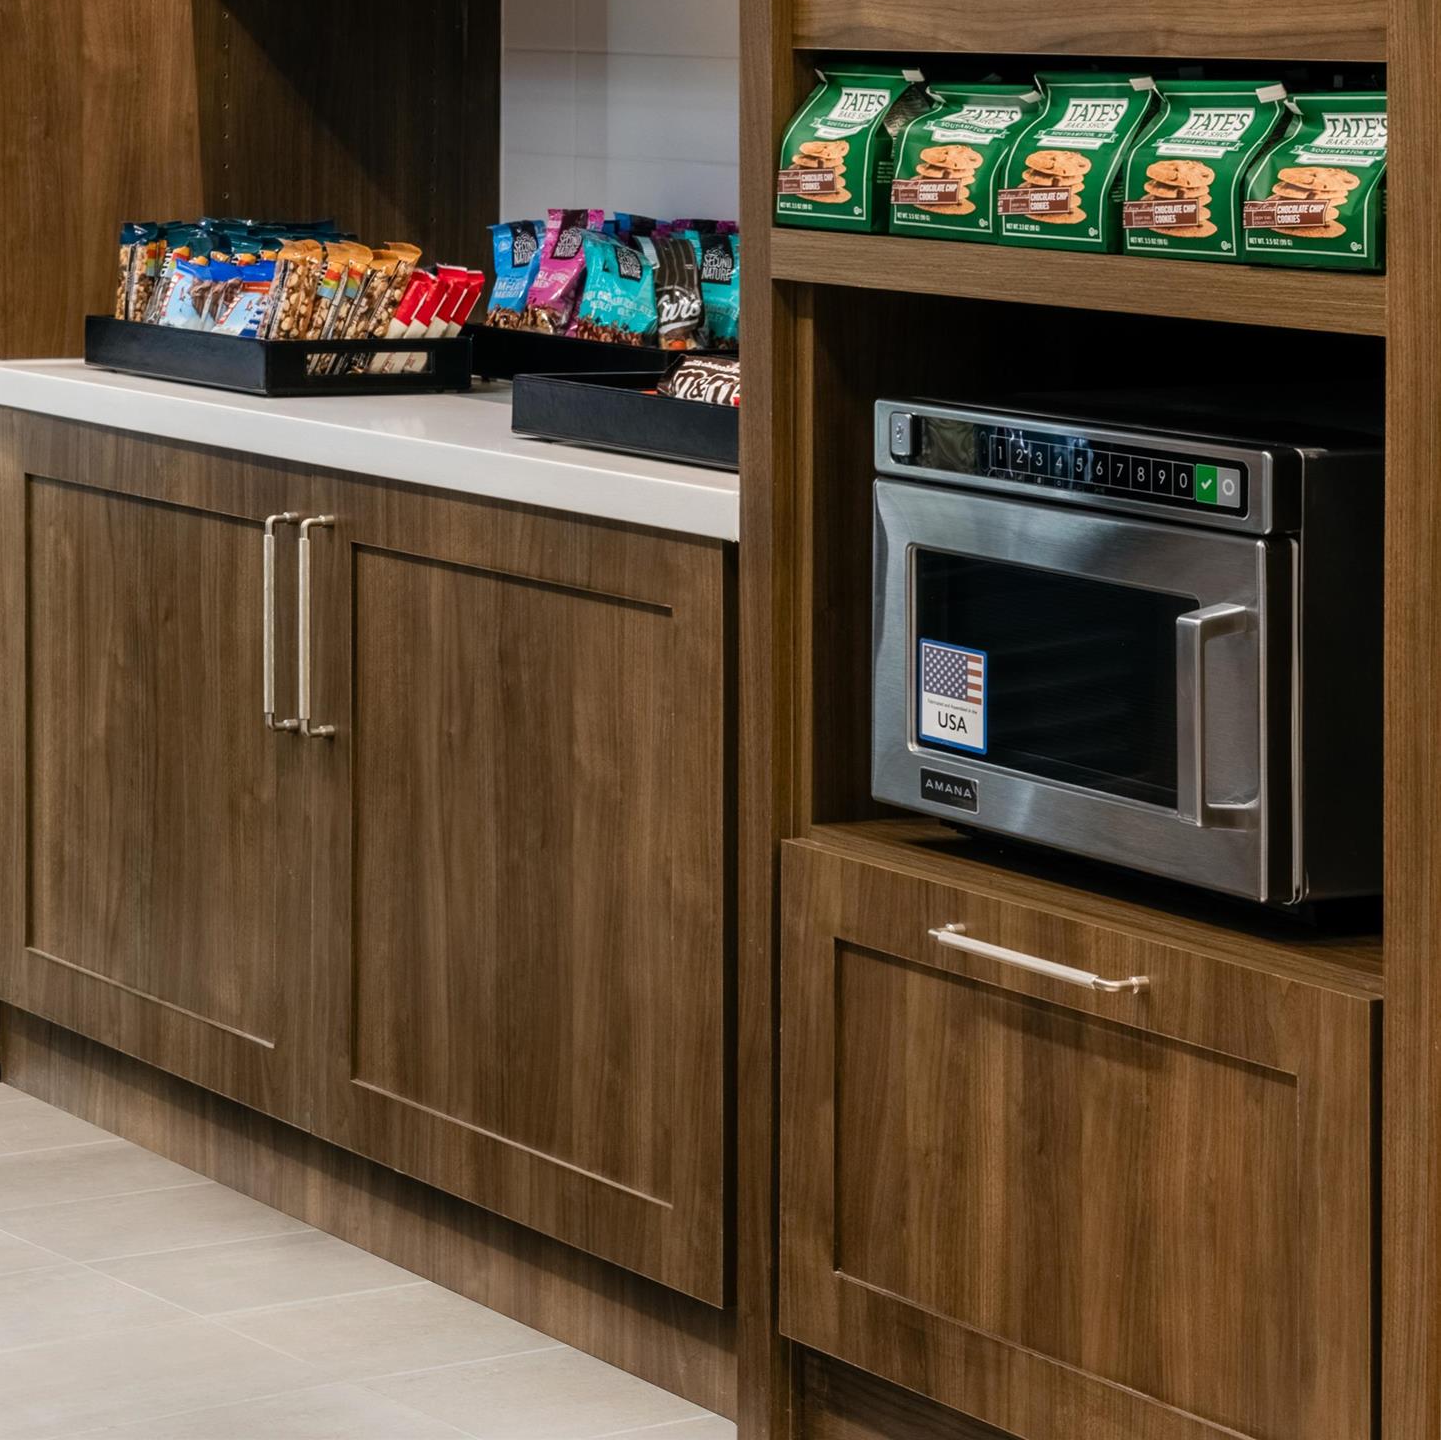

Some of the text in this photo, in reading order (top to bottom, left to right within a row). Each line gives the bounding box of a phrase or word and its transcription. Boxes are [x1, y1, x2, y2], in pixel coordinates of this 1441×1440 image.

[842, 91, 886, 113] TATE'S
[1071, 103, 1121, 122] TATE'S
[1209, 130, 1233, 138] SHOP
[1154, 204, 1197, 215] CHOCOLATE CHIP
[1277, 204, 1307, 215] CHOCOLATE
[1154, 215, 1177, 223] COOKIES
[1277, 215, 1301, 224] COOKIES
[1016, 449, 1188, 488] 2 3 4 5 6 7 8 9 0
[937, 711, 968, 733] USA
[925, 779, 972, 799] AMANA
